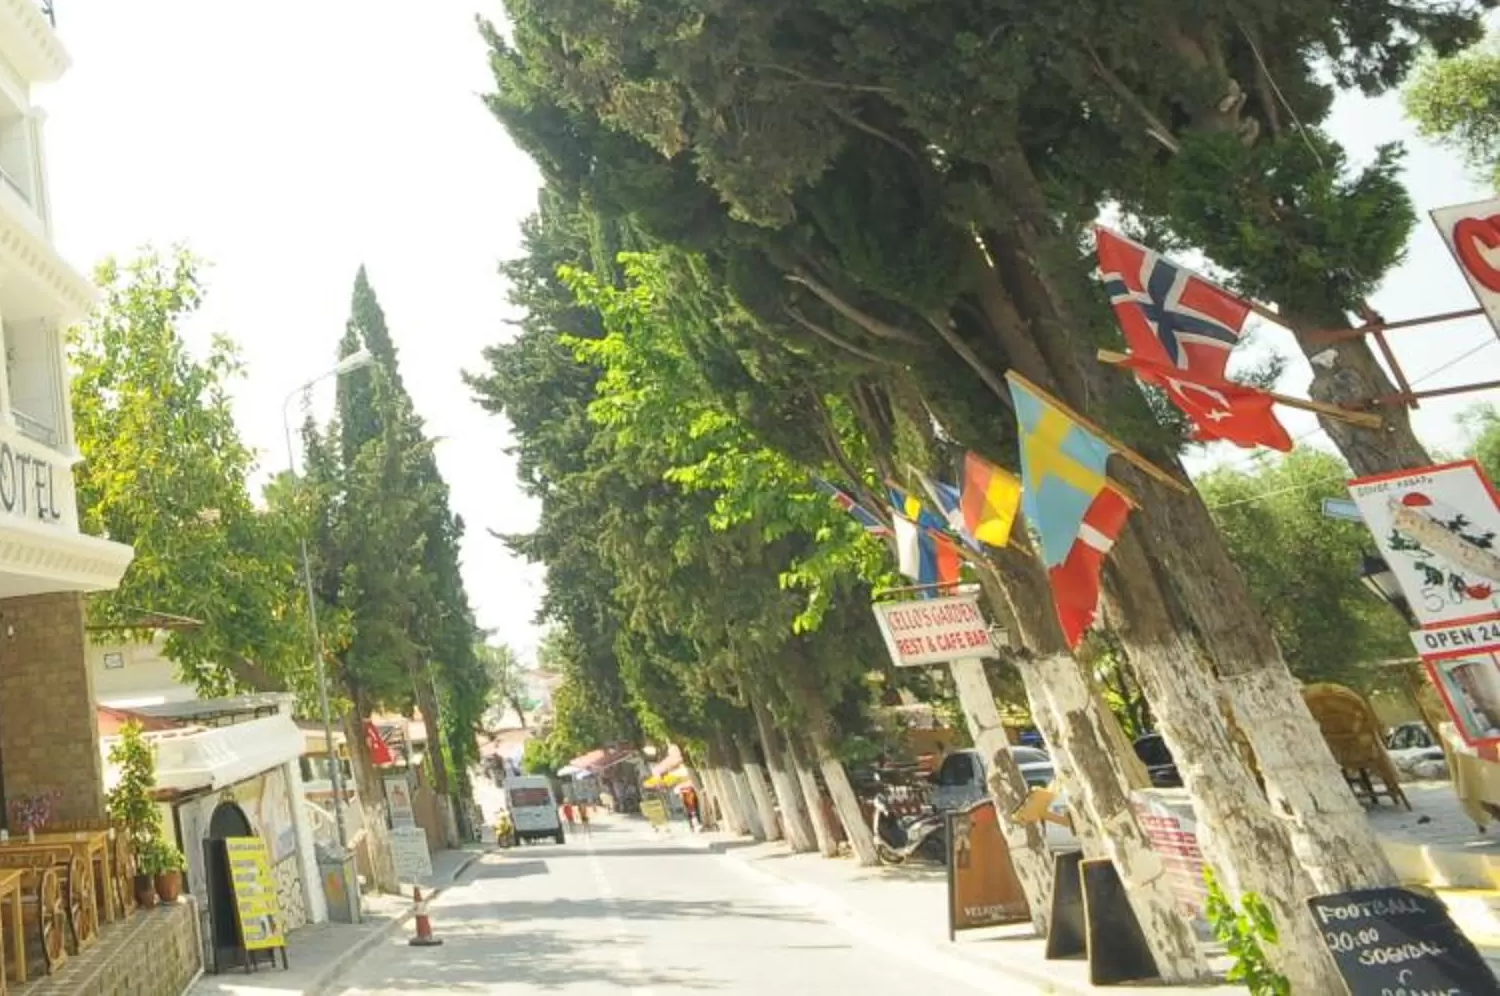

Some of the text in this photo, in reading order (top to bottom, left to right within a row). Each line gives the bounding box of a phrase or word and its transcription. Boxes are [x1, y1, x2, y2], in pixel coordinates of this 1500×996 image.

[888, 603, 979, 630] CELLO'S GARDEN
[896, 629, 989, 655] REST & CAFE BAR
[1424, 628, 1476, 649] OPEN
